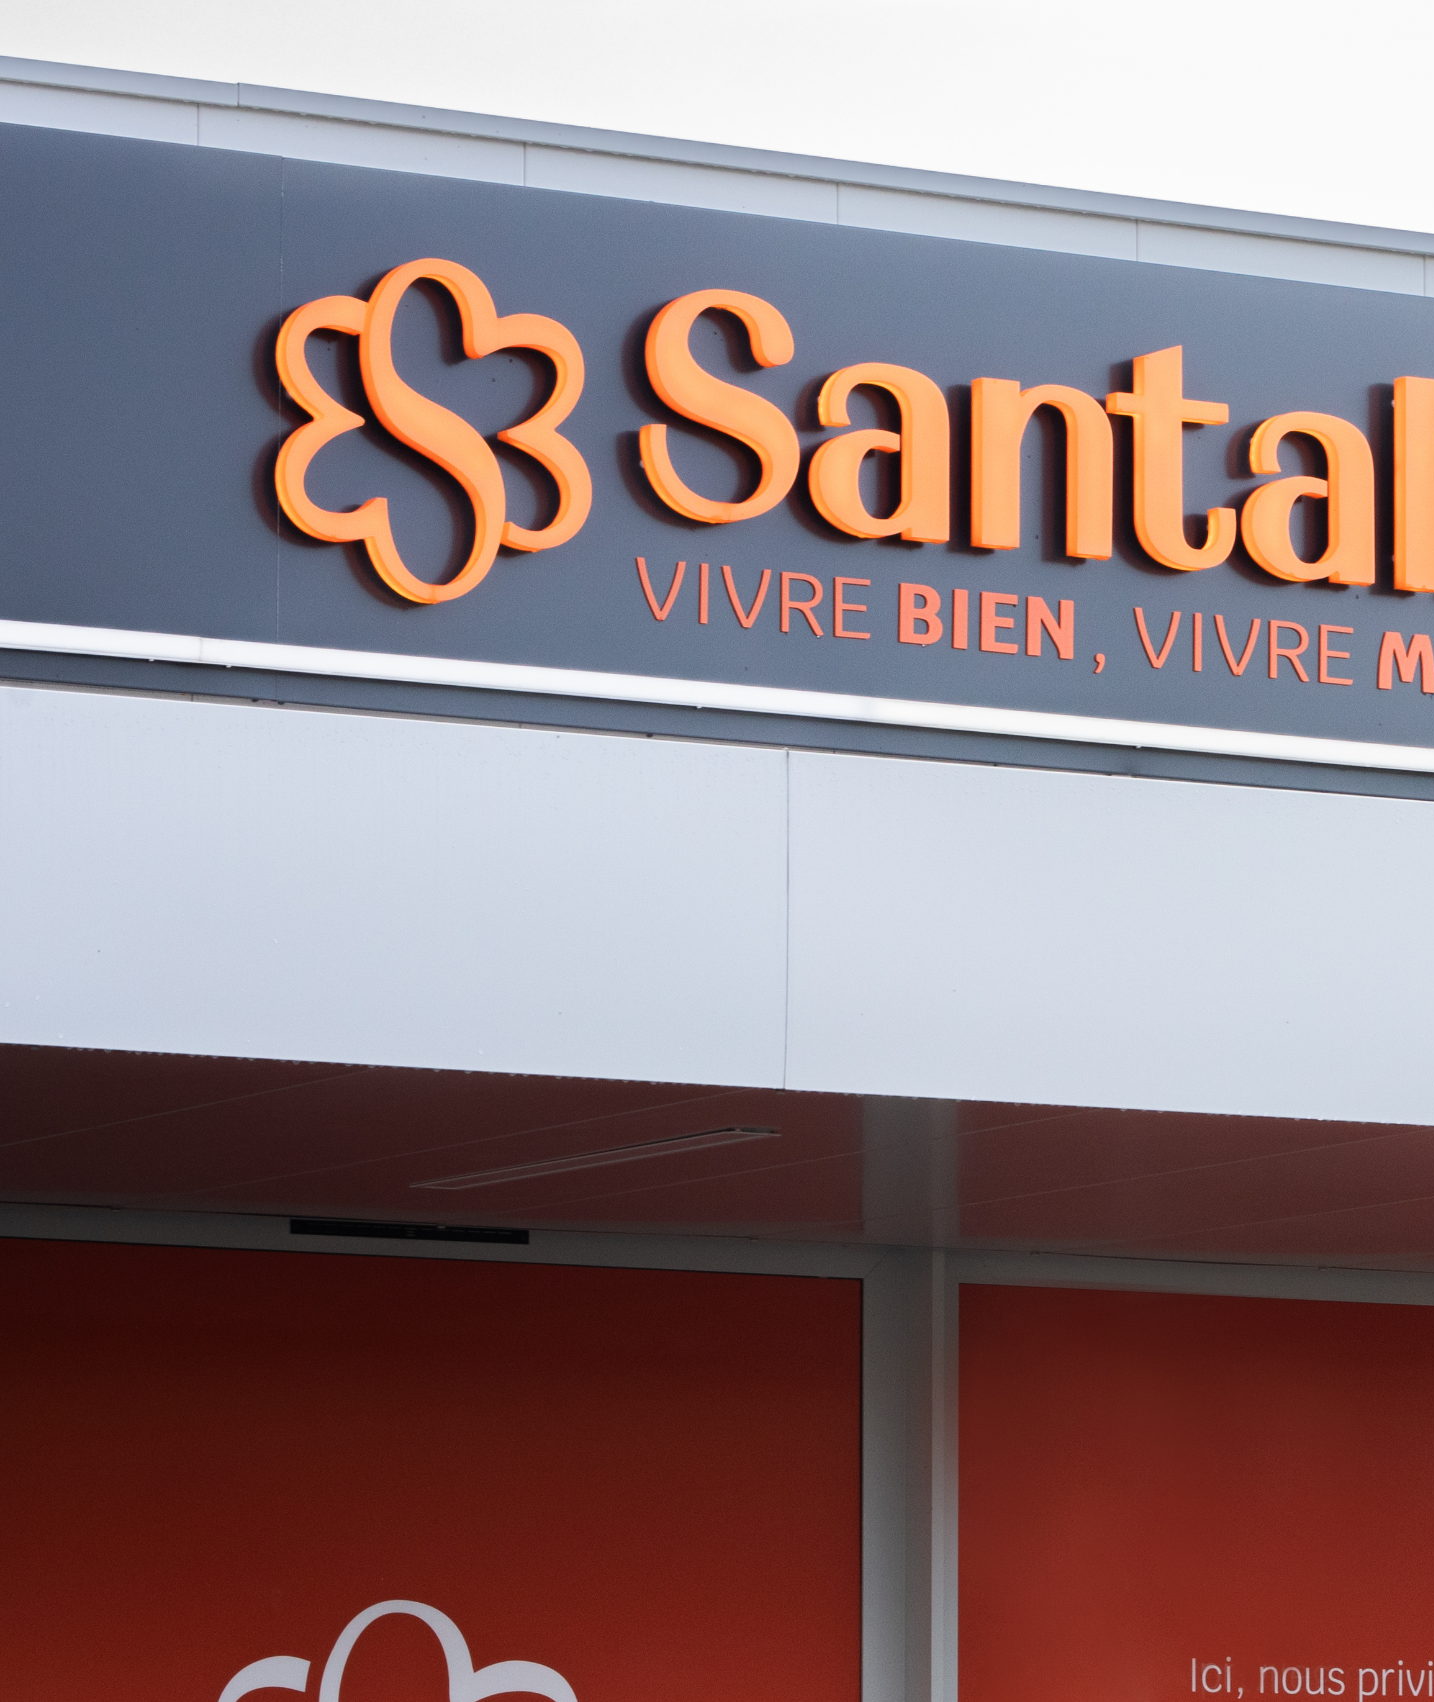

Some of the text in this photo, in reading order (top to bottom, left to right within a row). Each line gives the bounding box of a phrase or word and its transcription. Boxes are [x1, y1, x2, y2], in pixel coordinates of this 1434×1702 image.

[636, 556, 871, 640] VIVRE
[1133, 606, 1354, 686] VIVRE
[1191, 1657, 1244, 1699] Ici,
[1259, 1666, 1346, 1696] nous
